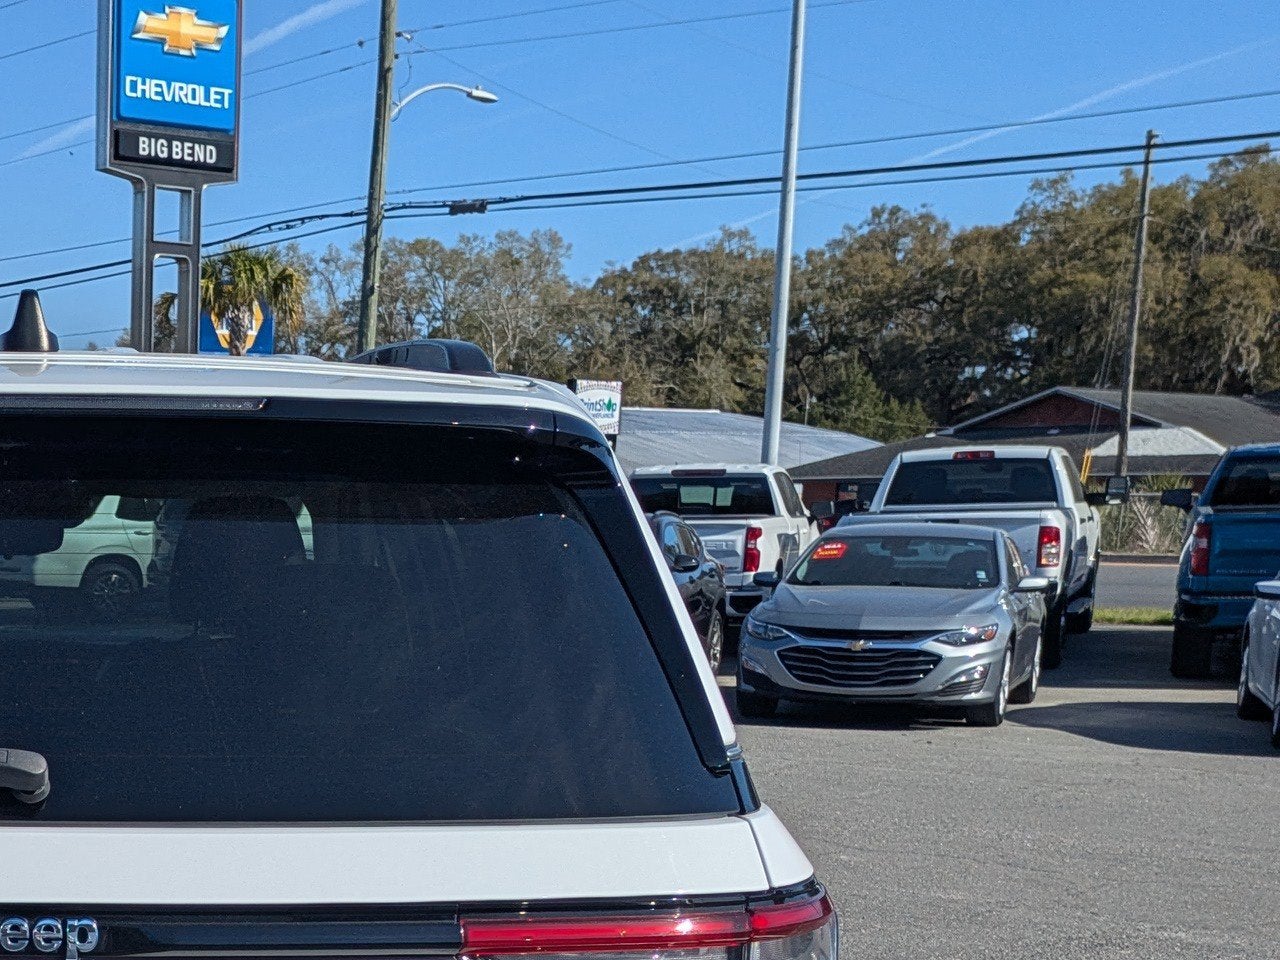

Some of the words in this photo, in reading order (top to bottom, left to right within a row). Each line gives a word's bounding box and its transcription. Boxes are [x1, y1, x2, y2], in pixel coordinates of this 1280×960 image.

[125, 75, 233, 110] CHEVROLET
[138, 136, 168, 159] BIG
[171, 140, 217, 164] BEND
